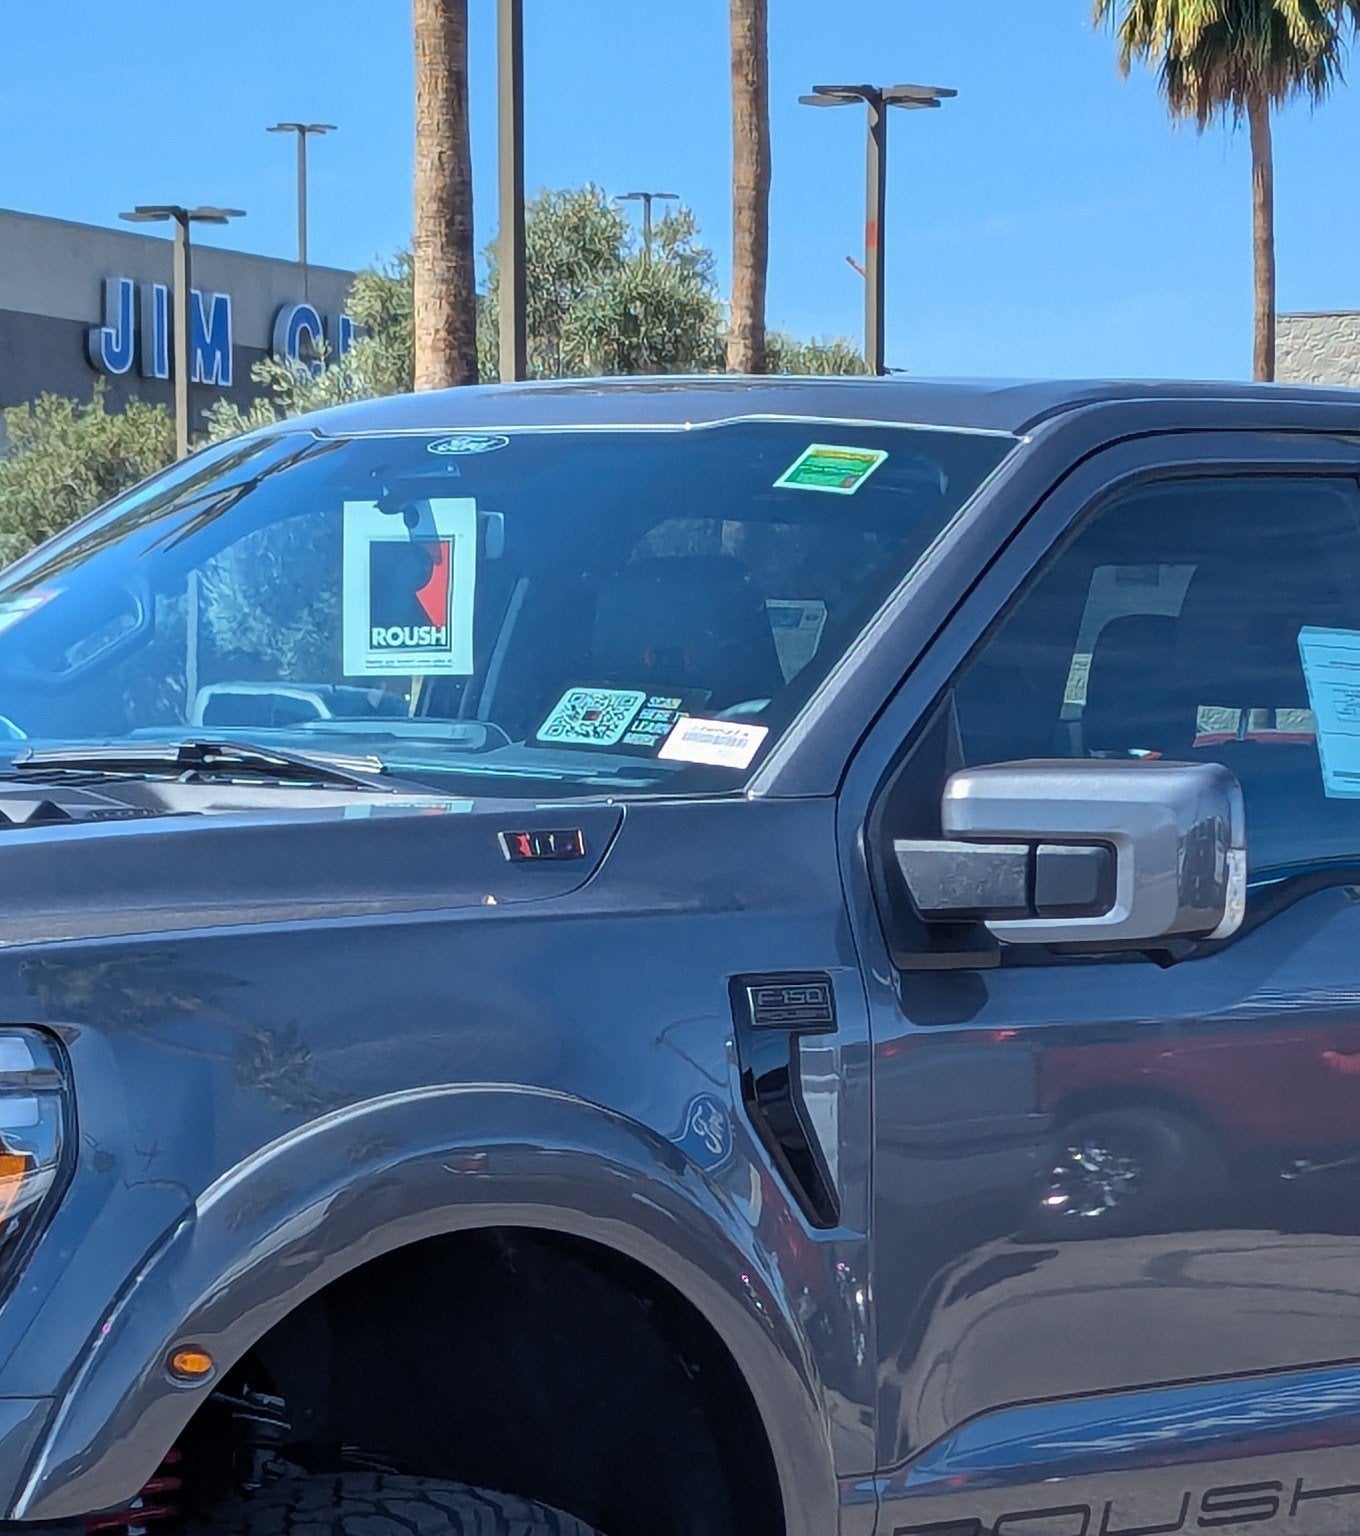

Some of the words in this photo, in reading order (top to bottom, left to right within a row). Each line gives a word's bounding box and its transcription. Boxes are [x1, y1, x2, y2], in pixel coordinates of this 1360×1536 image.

[92, 277, 233, 387] JIM
[371, 625, 448, 648] ROUSH
[757, 988, 824, 1006] F-150
